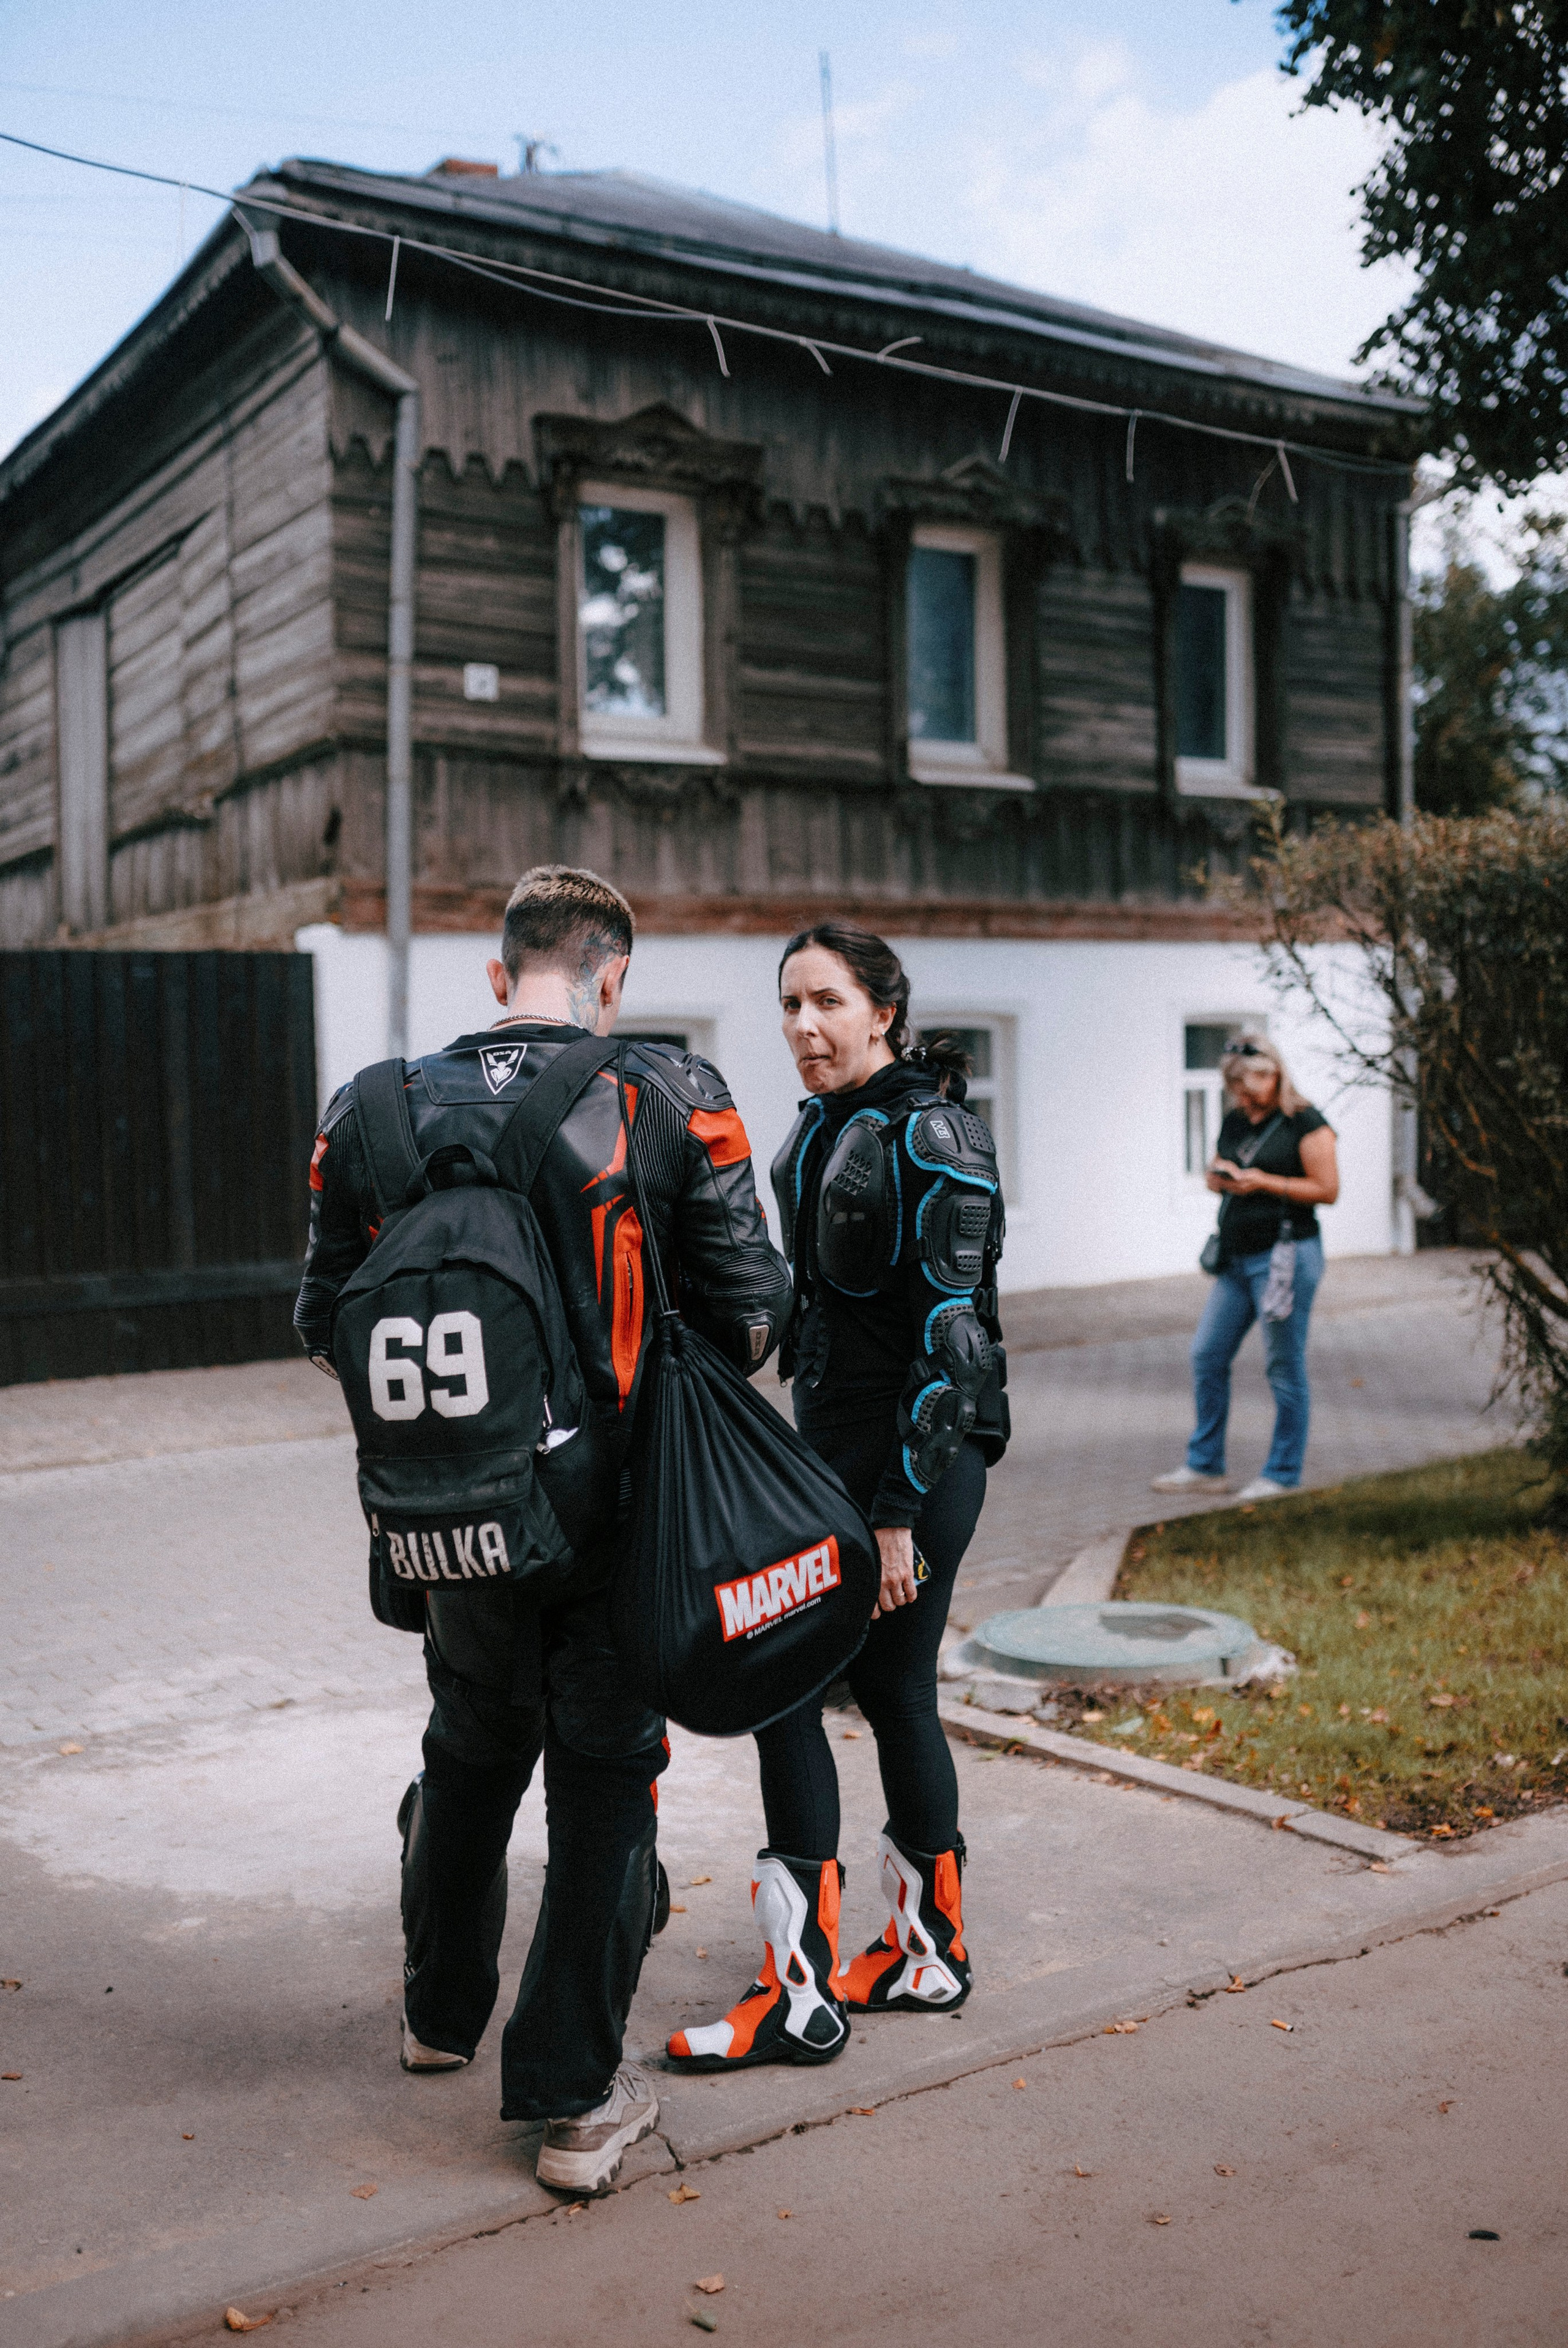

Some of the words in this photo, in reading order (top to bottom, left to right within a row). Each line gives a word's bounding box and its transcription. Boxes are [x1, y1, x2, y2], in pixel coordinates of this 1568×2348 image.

[369, 1310, 489, 1421] 69
[386, 1522, 511, 1581] BULKA
[719, 1544, 838, 1637] MARVEL
[754, 1616, 783, 1637] MARVEL
[784, 1596, 822, 1620] marvel.com
